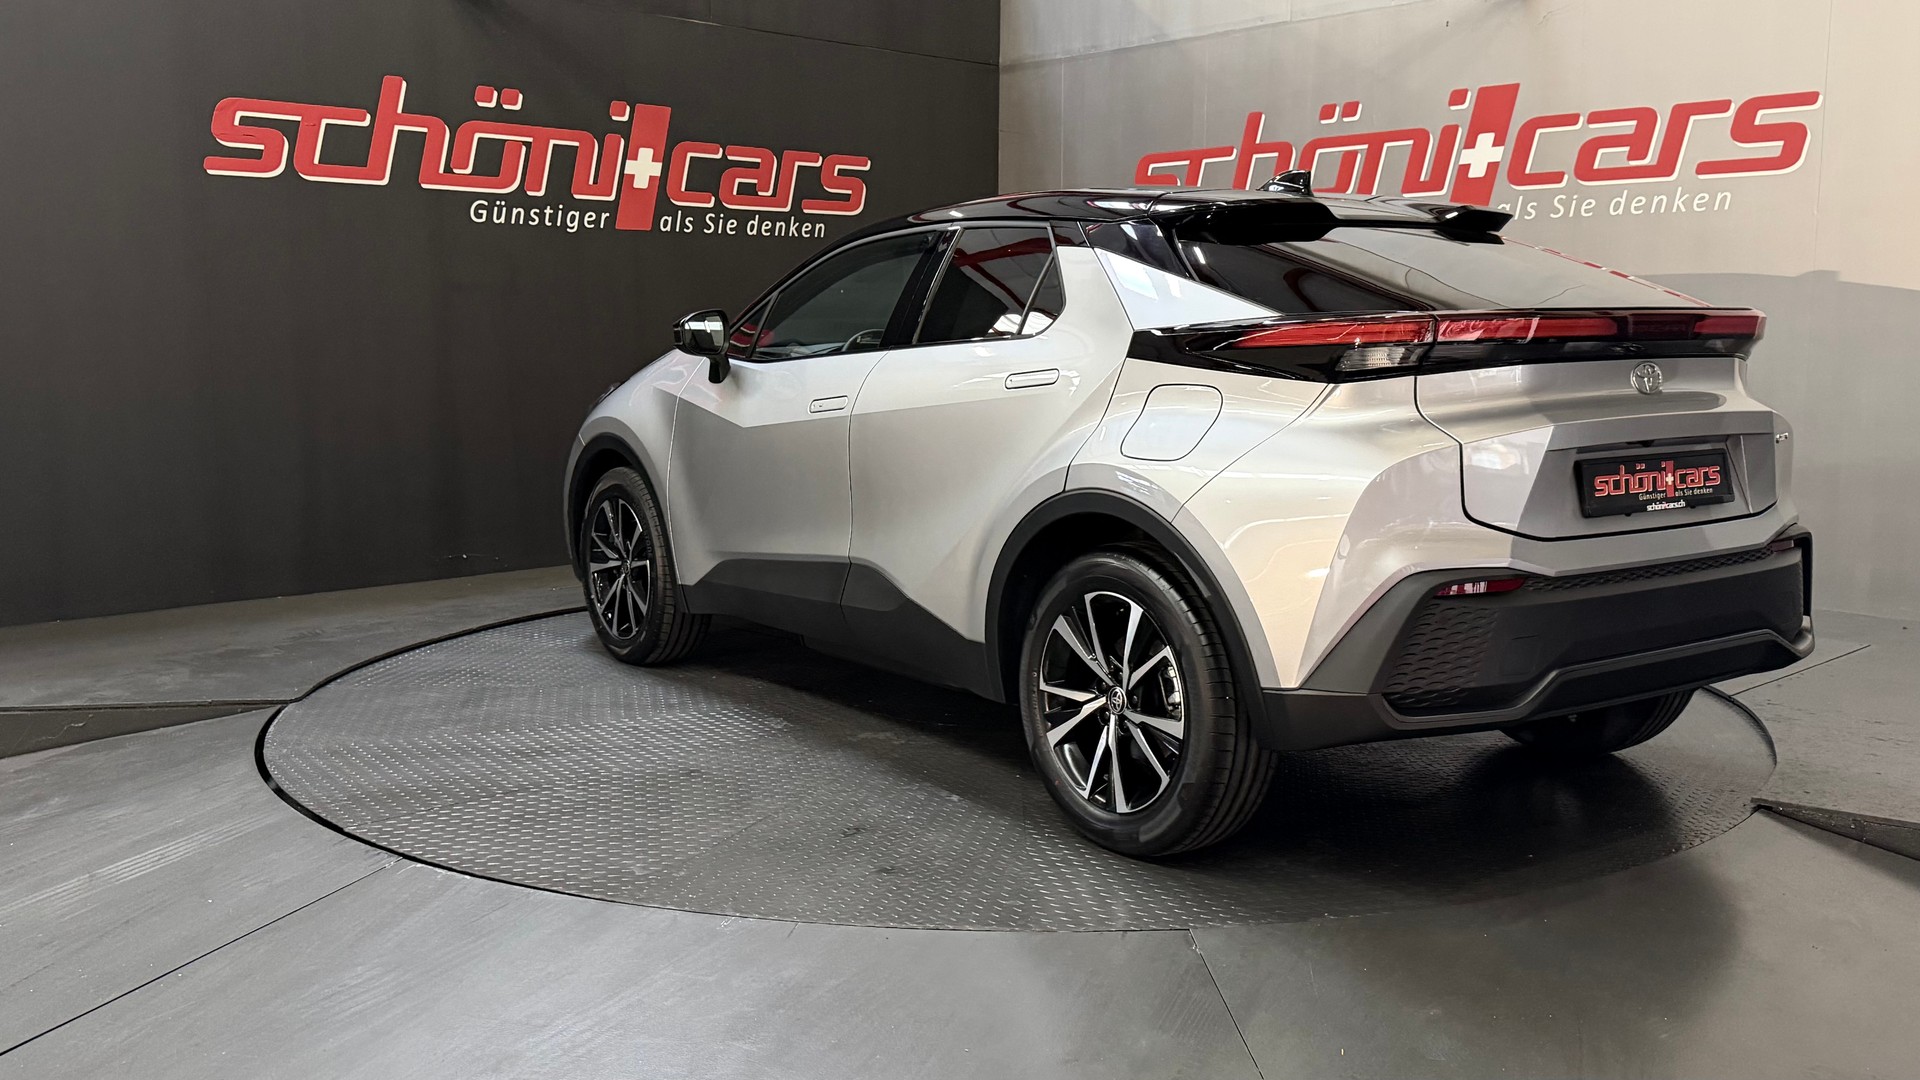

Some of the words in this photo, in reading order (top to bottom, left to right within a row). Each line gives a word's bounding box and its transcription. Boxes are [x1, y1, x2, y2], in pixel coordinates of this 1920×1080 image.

[469, 199, 610, 233] Günstiger
[659, 210, 694, 233] als
[703, 212, 738, 235] Sie
[746, 214, 827, 239] denken
[1550, 193, 1597, 219] Sie
[1609, 187, 1733, 216] denken
